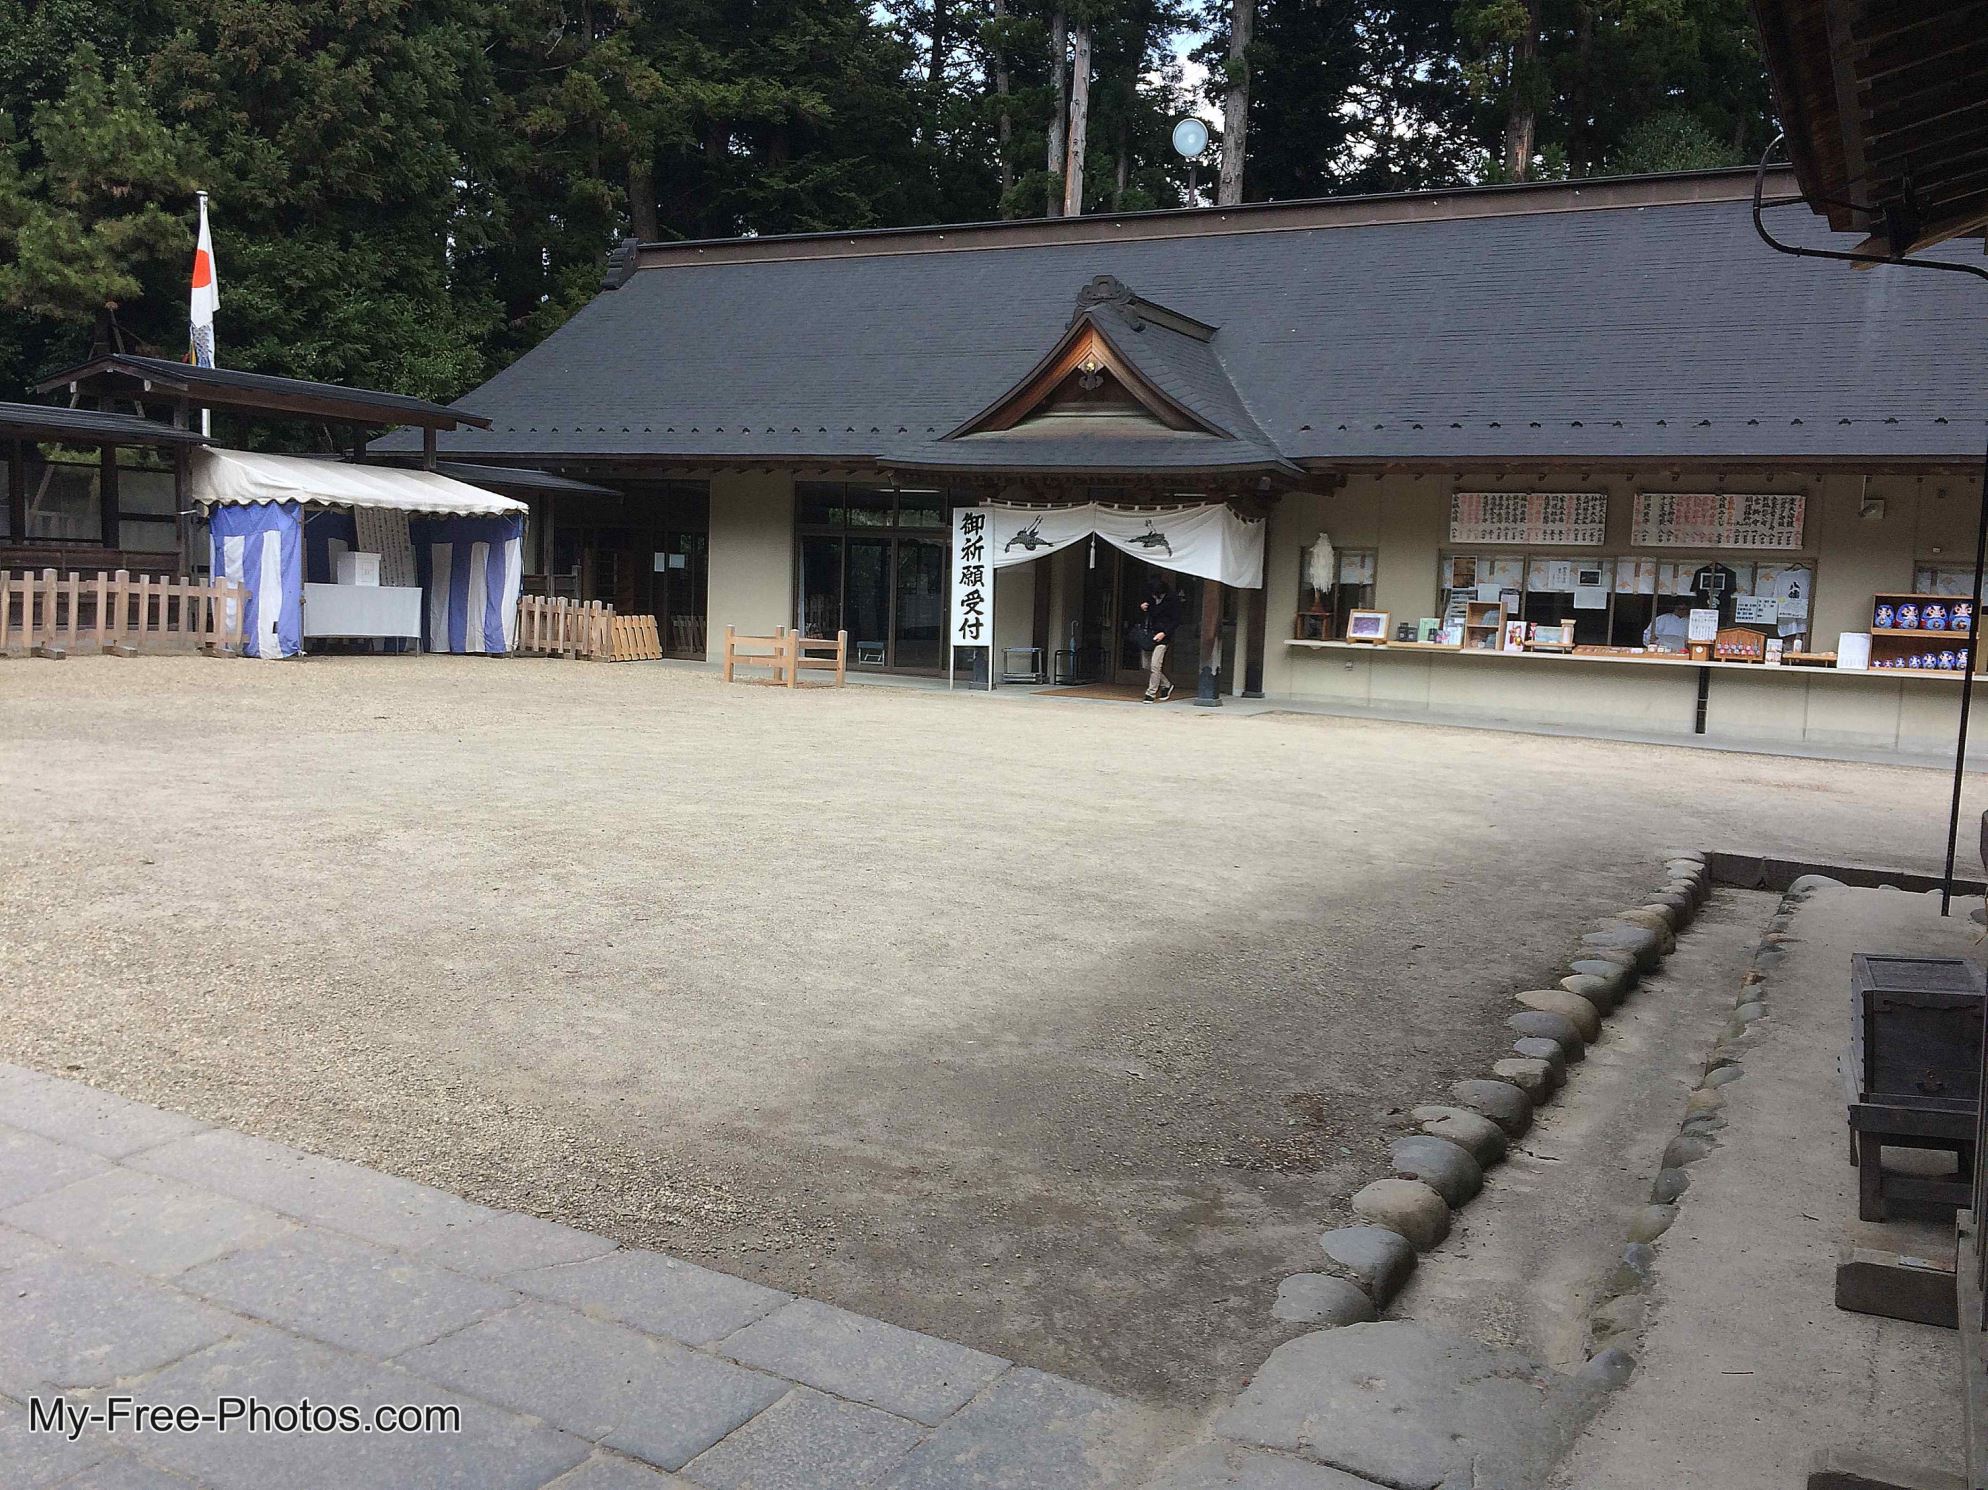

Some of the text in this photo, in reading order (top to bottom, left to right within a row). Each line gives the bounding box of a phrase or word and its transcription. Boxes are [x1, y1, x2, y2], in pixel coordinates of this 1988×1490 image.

[958, 512, 986, 640] 御祈願受付
